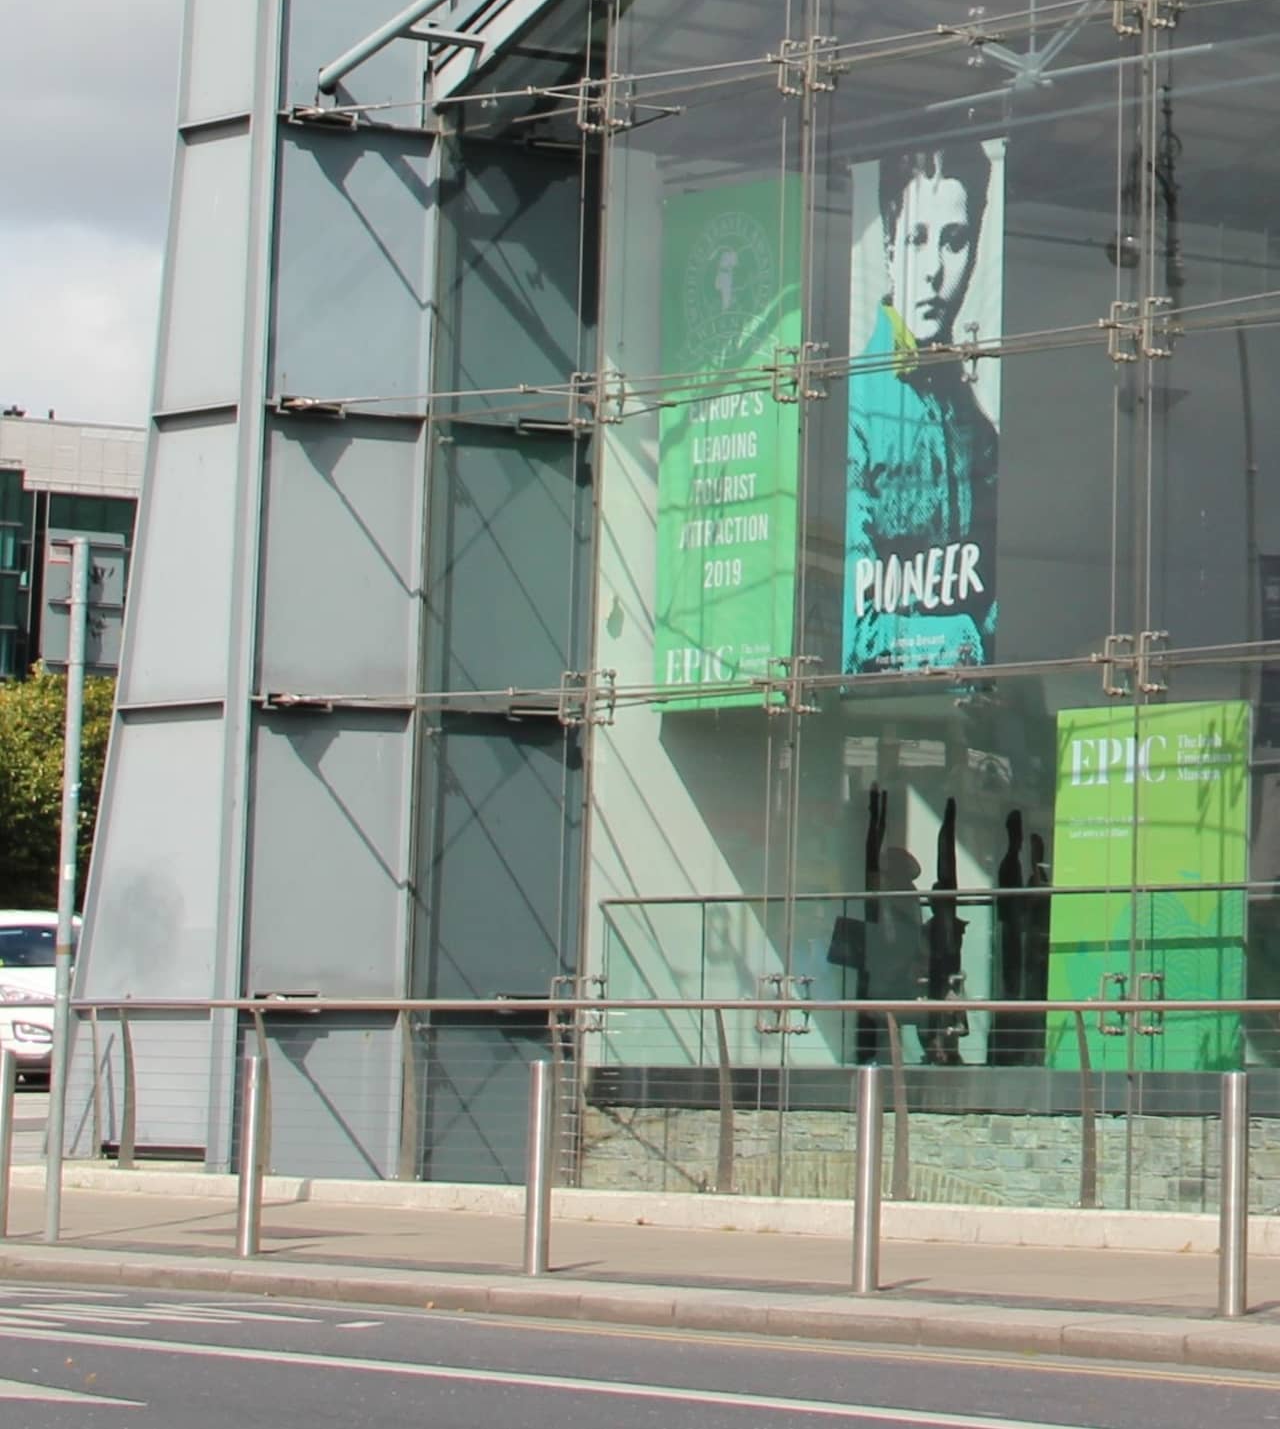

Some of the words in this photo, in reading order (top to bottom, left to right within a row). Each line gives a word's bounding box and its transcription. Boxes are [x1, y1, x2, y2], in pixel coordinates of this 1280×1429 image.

[693, 431, 758, 465] LEADING
[694, 473, 758, 506] TOURIST
[679, 514, 769, 550] ATTRACTION
[703, 558, 742, 589] 2019
[856, 542, 985, 618] PIONEER
[665, 644, 734, 686] EPIC
[1071, 734, 1168, 786] EPIC
